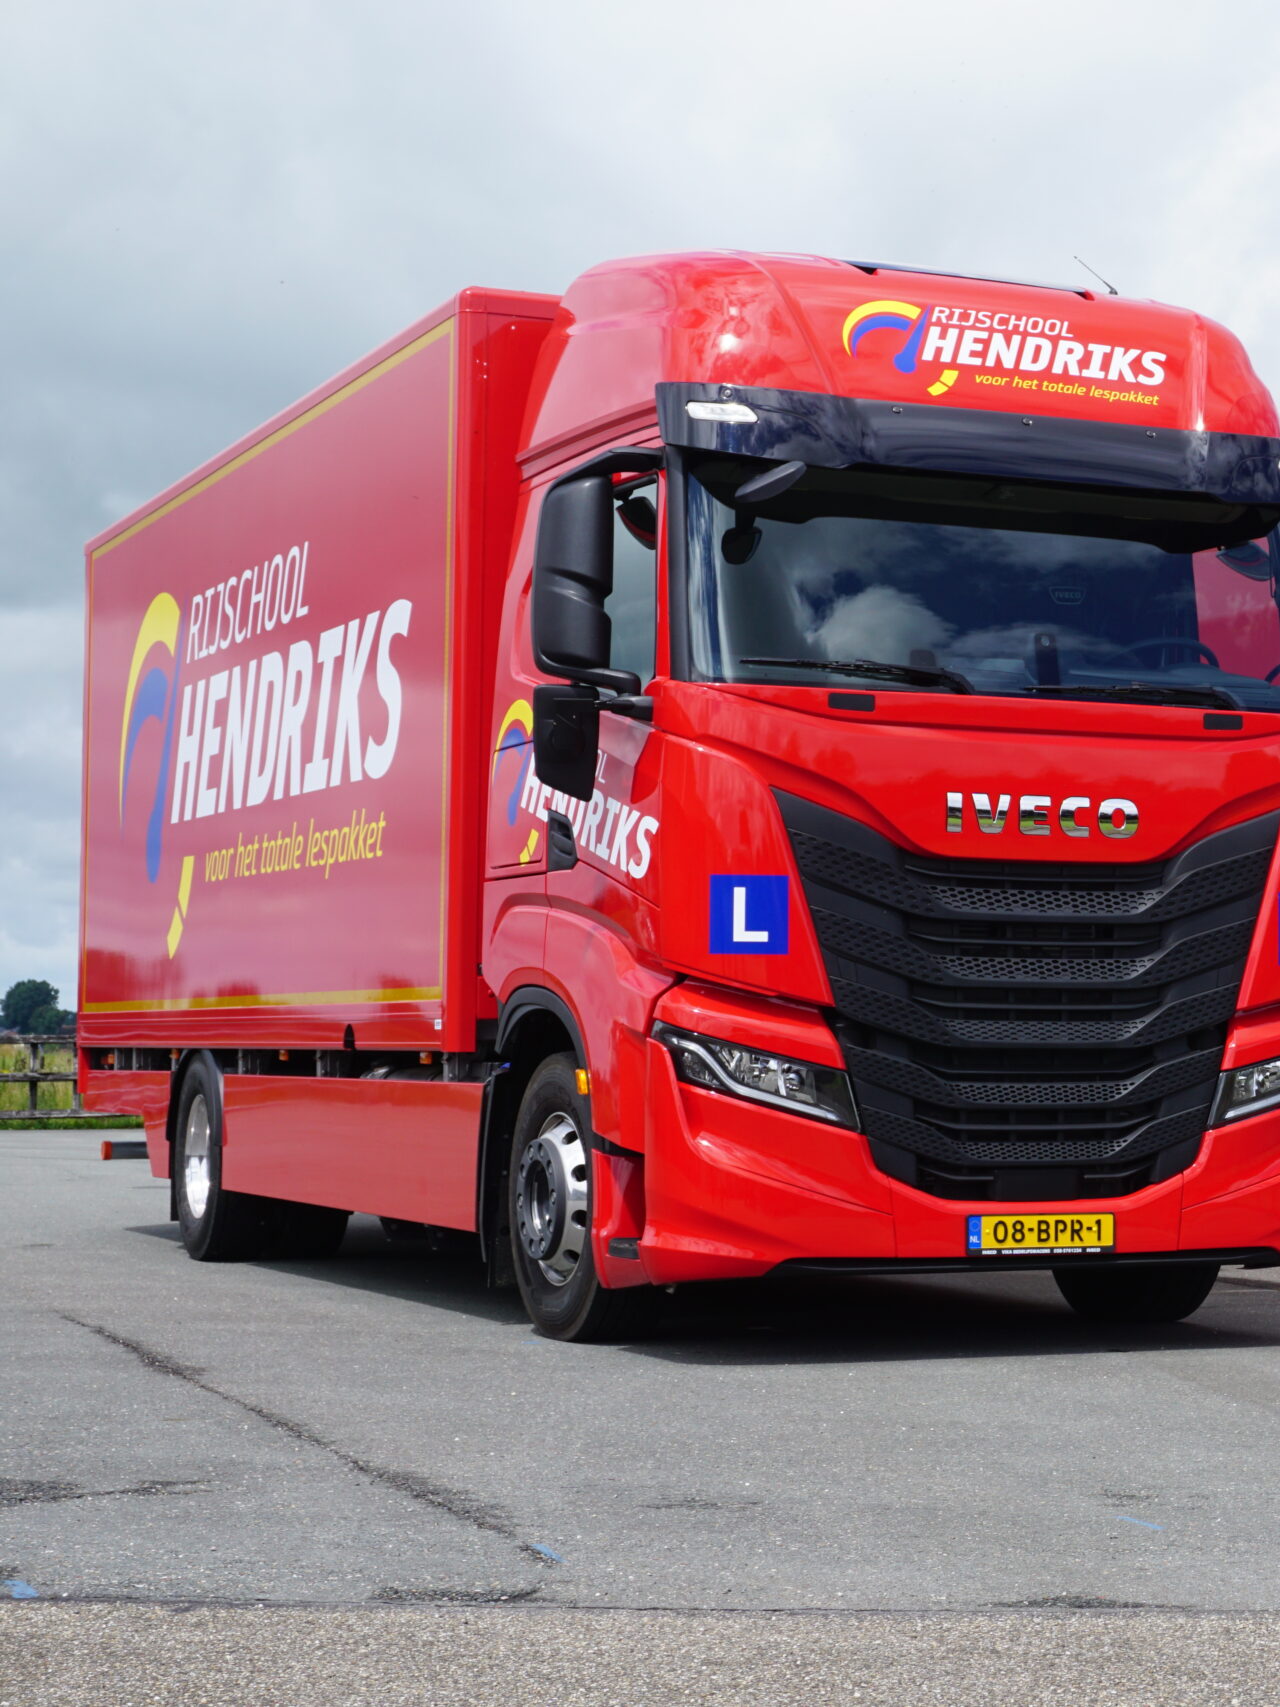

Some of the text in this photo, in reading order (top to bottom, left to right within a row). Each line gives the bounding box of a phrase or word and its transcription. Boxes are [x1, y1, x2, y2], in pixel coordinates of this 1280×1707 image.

[931, 306, 1075, 338] RIJSCHOOL
[921, 325, 1168, 386] HENDRIKS
[974, 373, 1161, 407] voor het totale lespakket
[186, 541, 309, 664] RIJSCHOOL
[170, 599, 413, 825] HENDRIKS
[946, 792, 1139, 839] IVECO
[205, 807, 386, 882] voor het totale lespakket
[732, 886, 769, 943] L
[969, 1235, 980, 1243] NL
[993, 1219, 1102, 1244] 08-BPR-1
